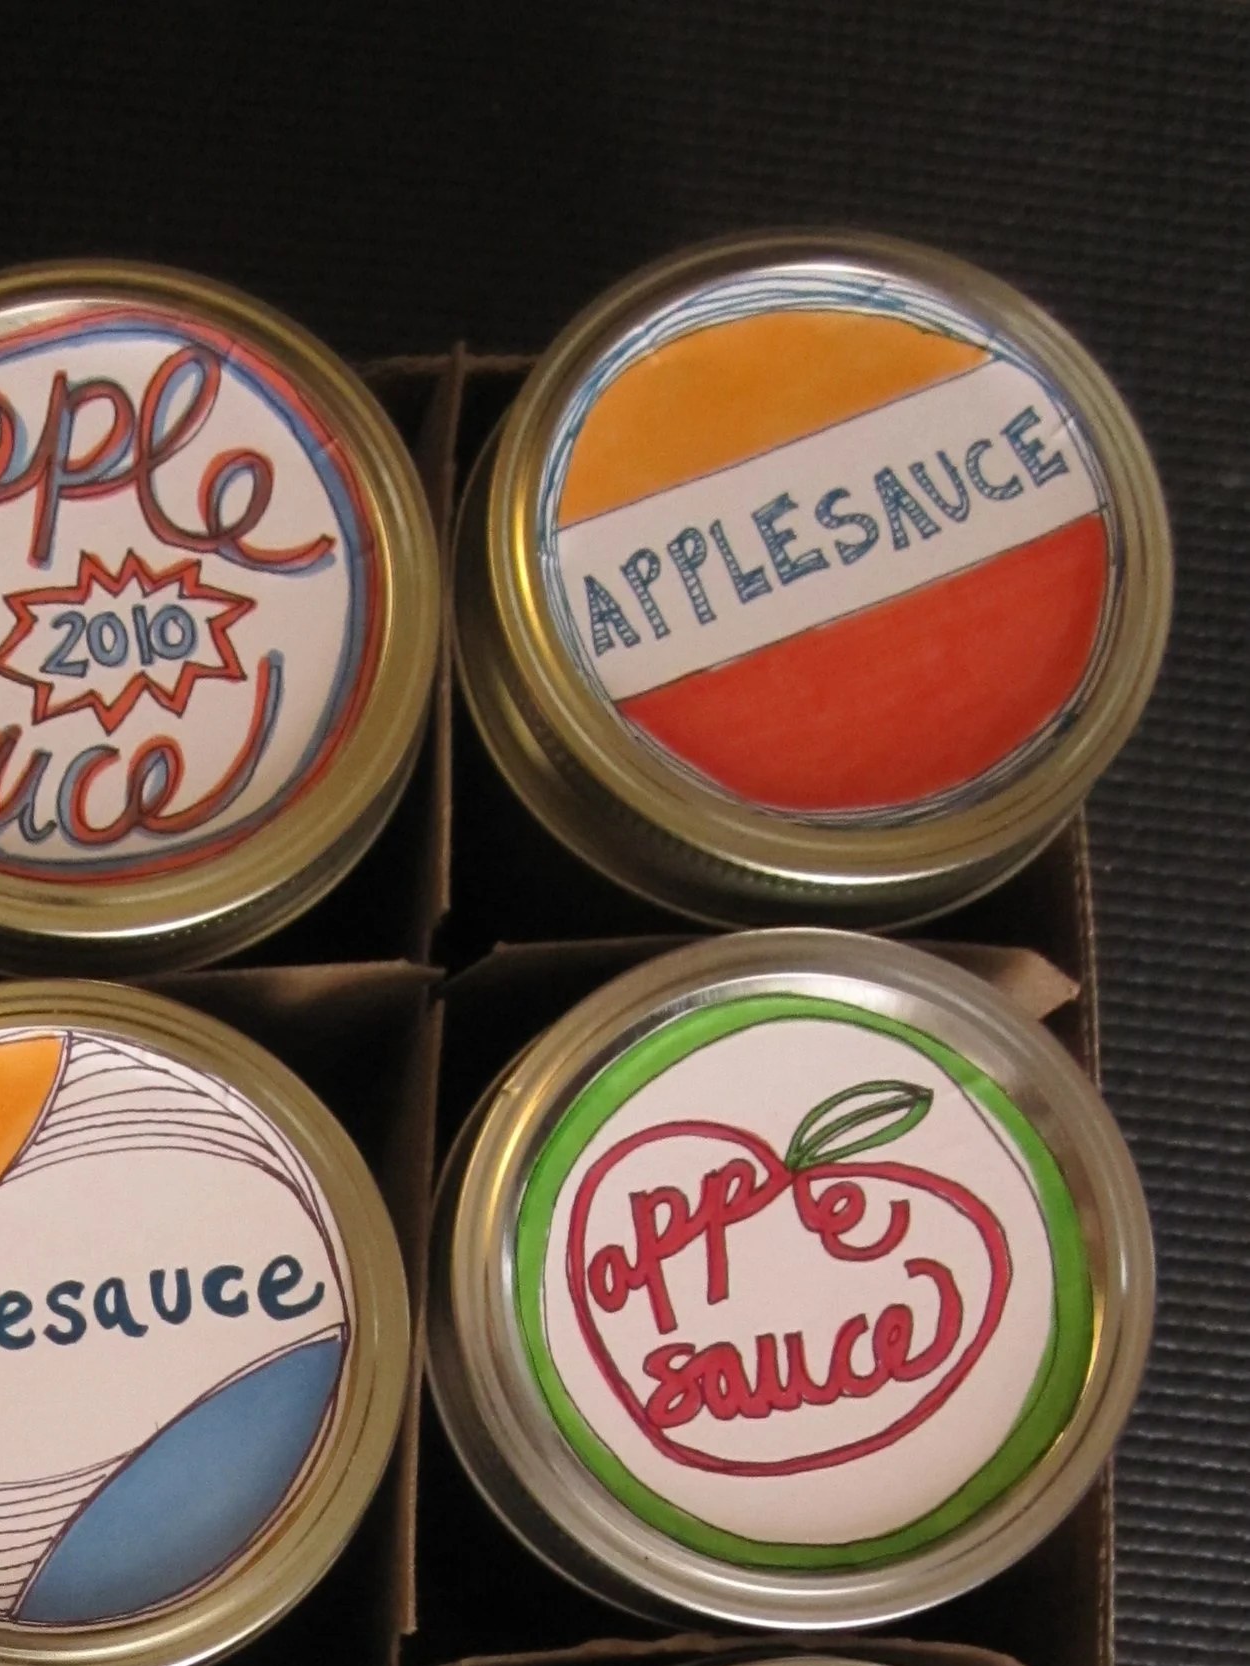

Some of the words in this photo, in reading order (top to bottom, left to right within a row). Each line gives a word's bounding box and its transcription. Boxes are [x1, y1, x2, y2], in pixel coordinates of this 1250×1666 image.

[583, 405, 1070, 656] APPLESAUCE
[39, 603, 199, 677] 2010
[642, 1256, 963, 1428] sauce
